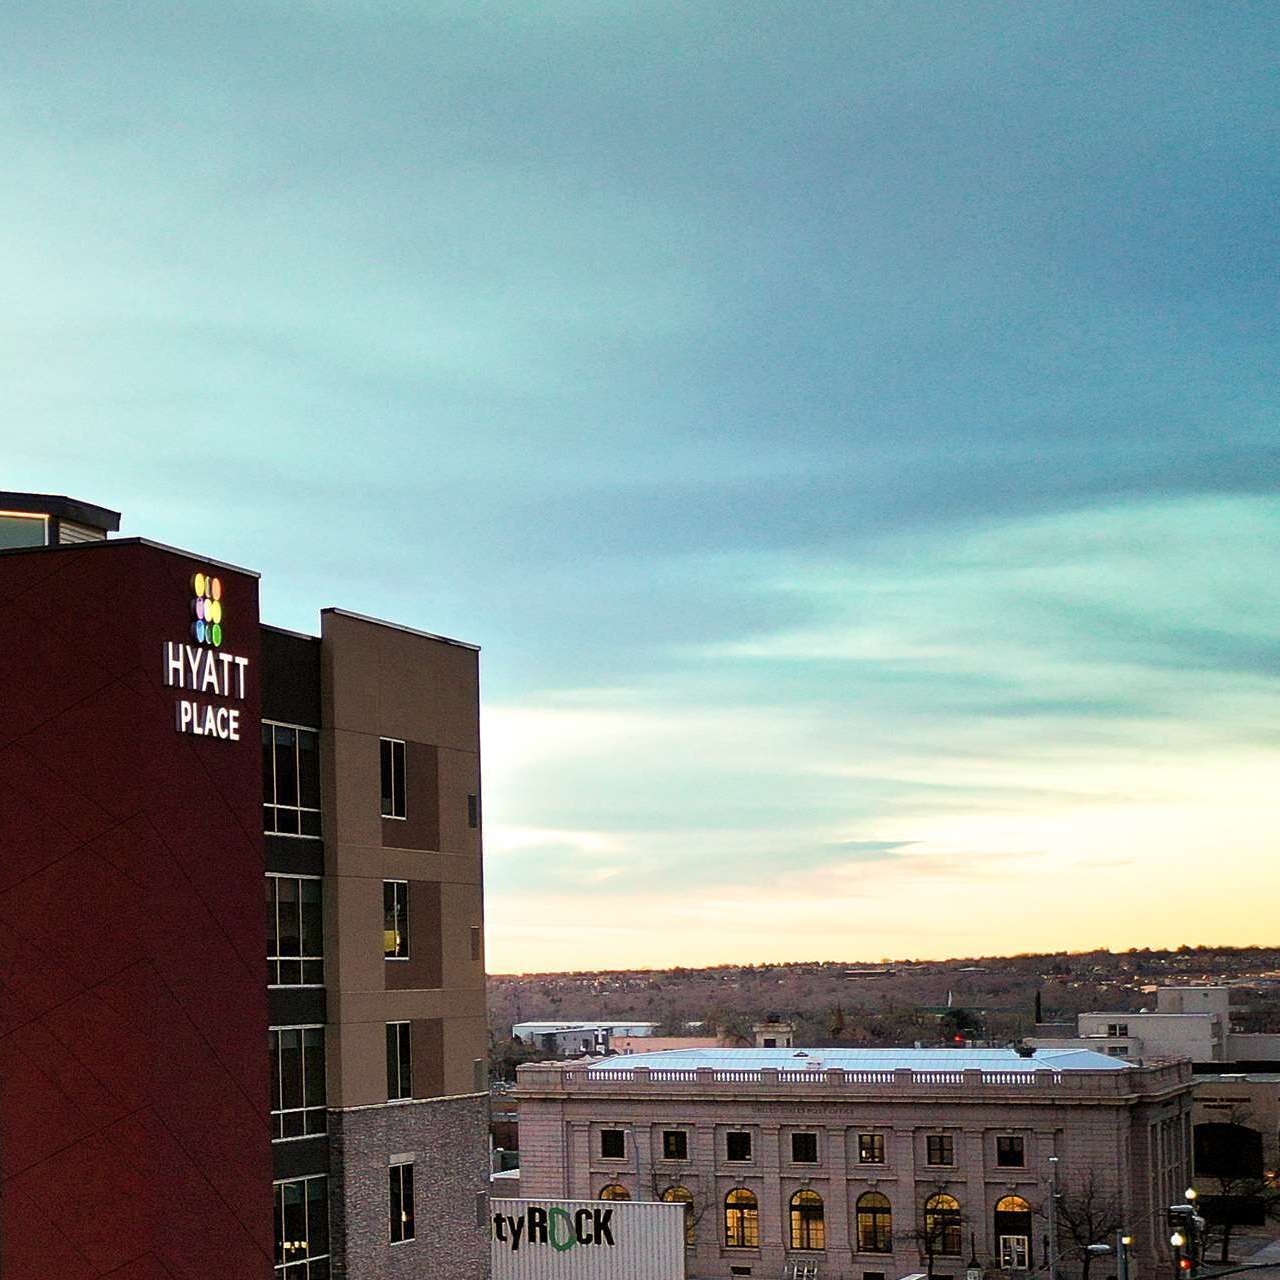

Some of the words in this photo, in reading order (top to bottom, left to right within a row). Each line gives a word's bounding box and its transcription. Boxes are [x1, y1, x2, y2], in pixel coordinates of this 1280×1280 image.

[165, 641, 249, 700] HYATT
[178, 700, 240, 741] PLACE
[494, 1206, 615, 1252] tyROCK
